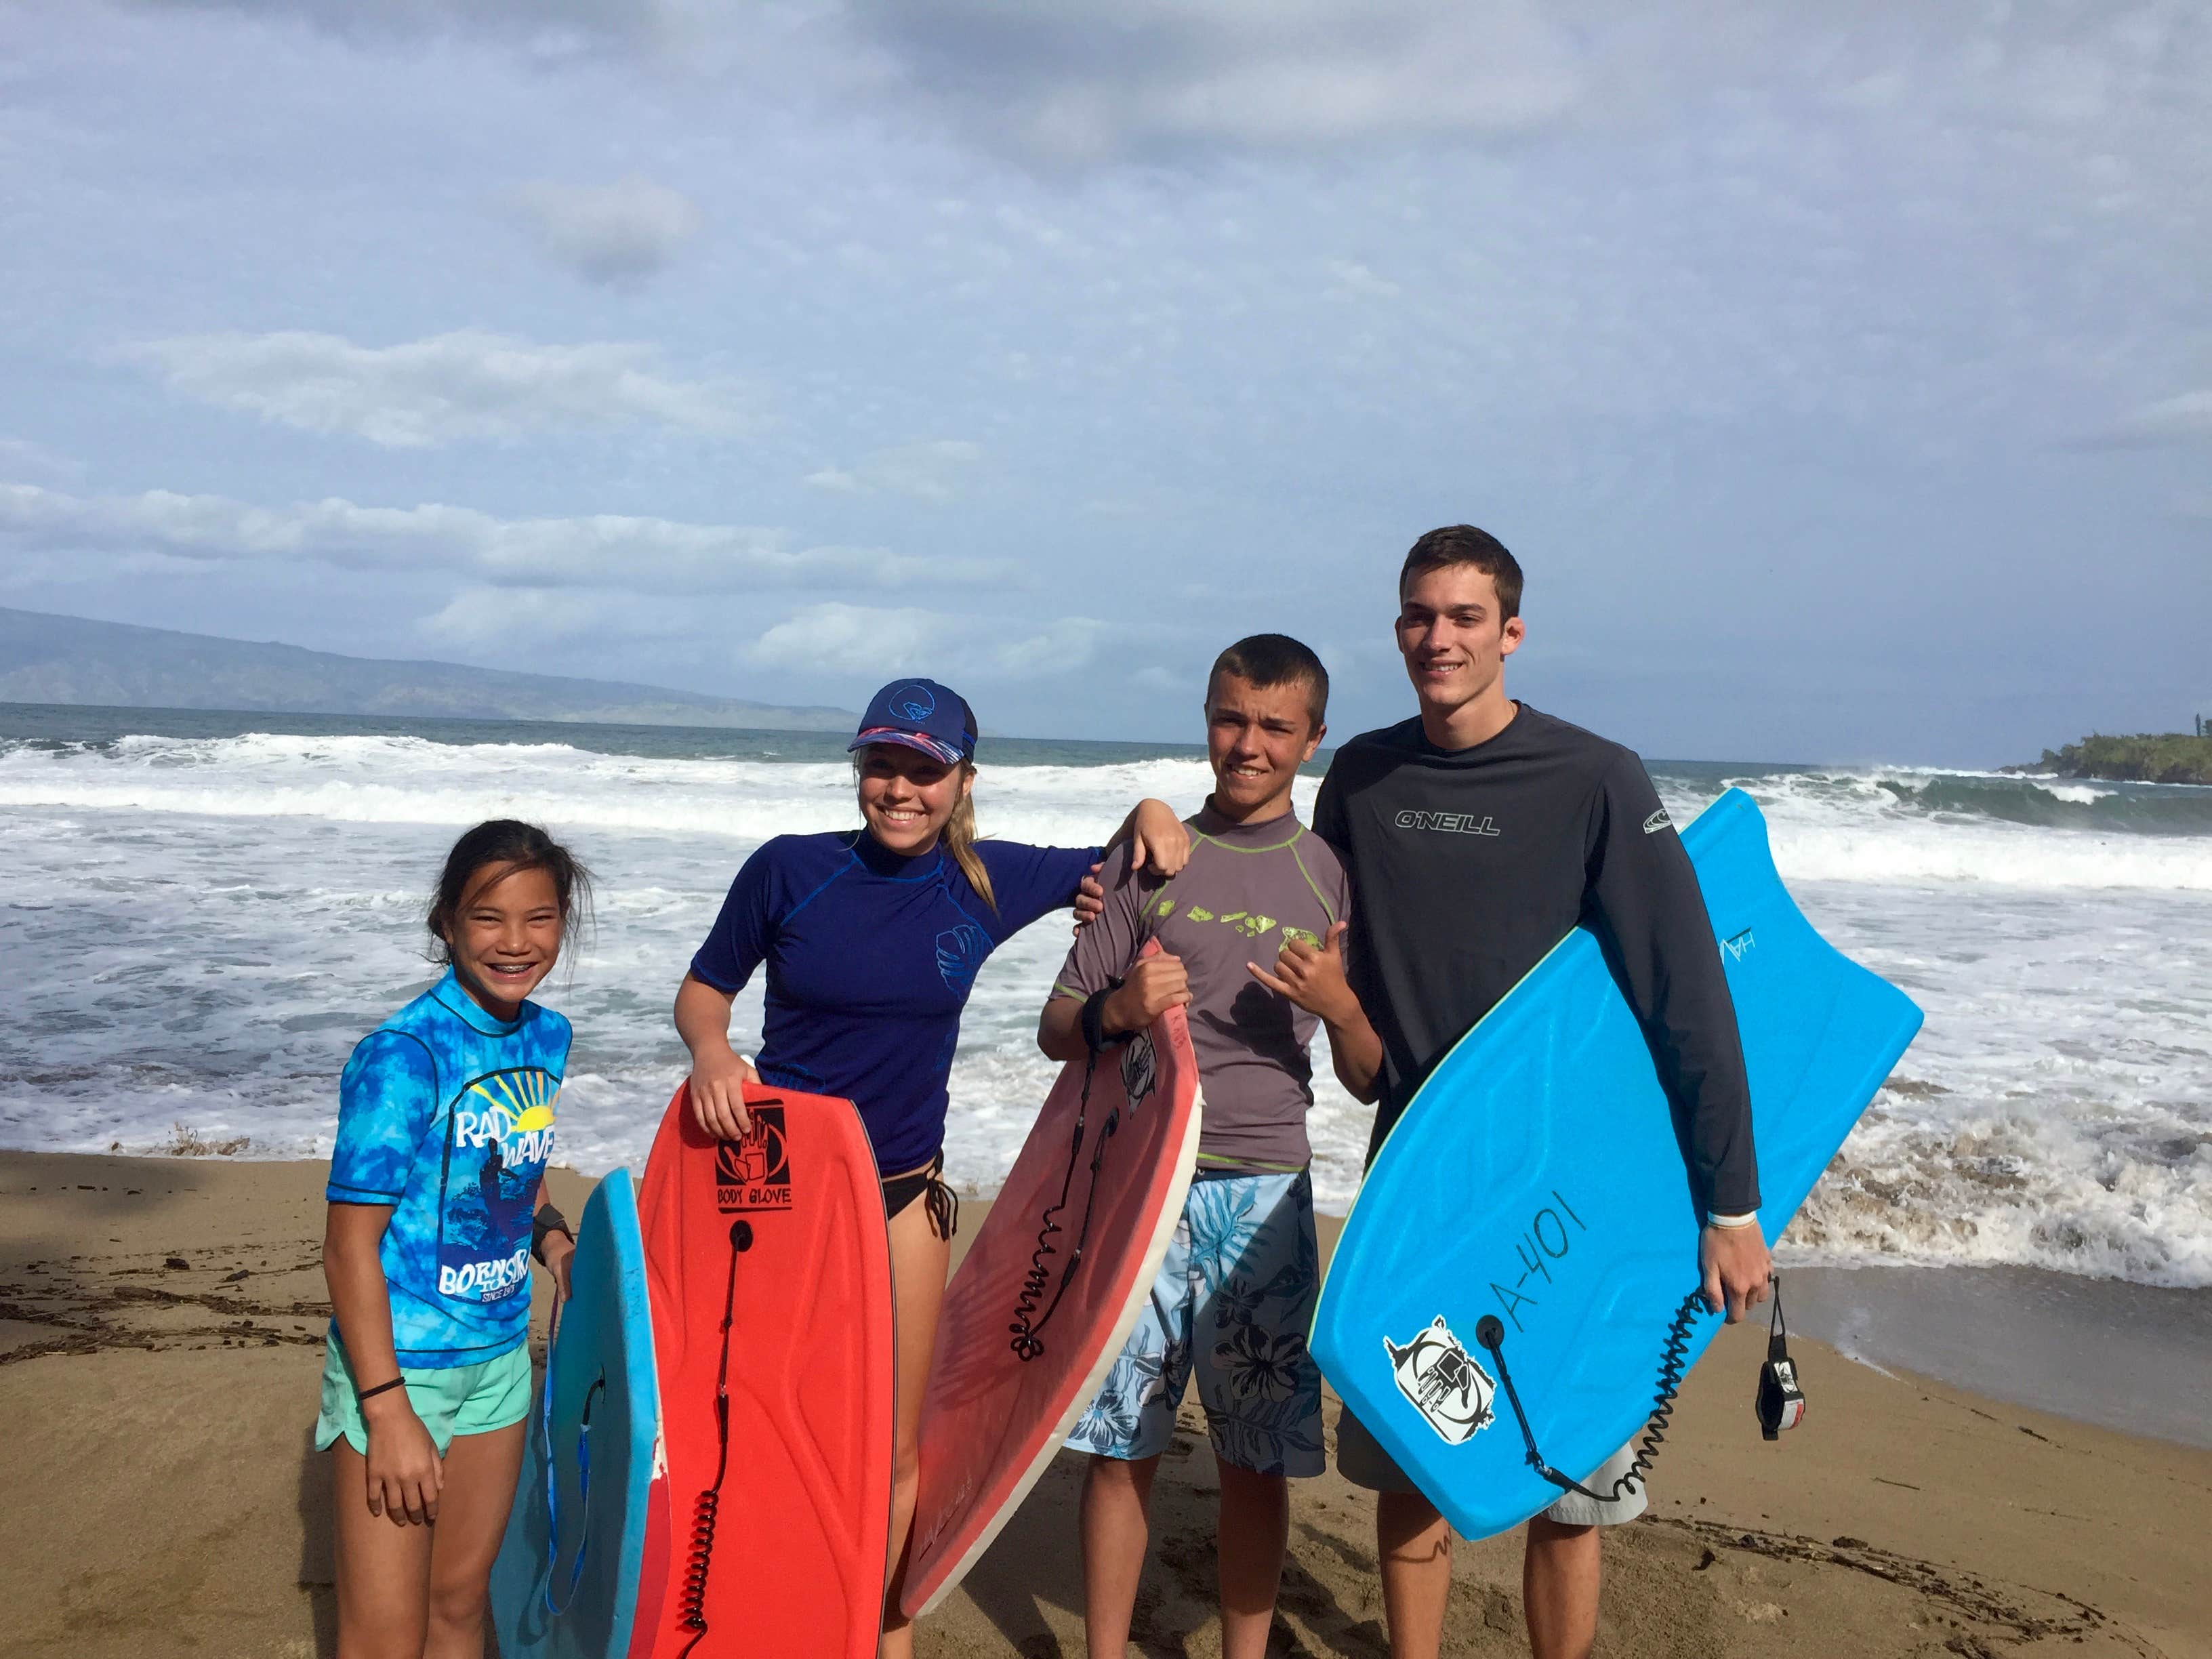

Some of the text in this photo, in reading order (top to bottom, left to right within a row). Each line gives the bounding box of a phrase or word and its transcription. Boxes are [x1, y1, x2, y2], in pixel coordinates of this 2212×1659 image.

[1395, 810, 1500, 836] O'NEILL
[455, 1105, 512, 1148] RAD
[717, 1188, 792, 1204] BODY GLOVE
[438, 1258, 507, 1294] BORN
[1489, 1190, 1586, 1333] A-401
[482, 1289, 504, 1303] SINCE
